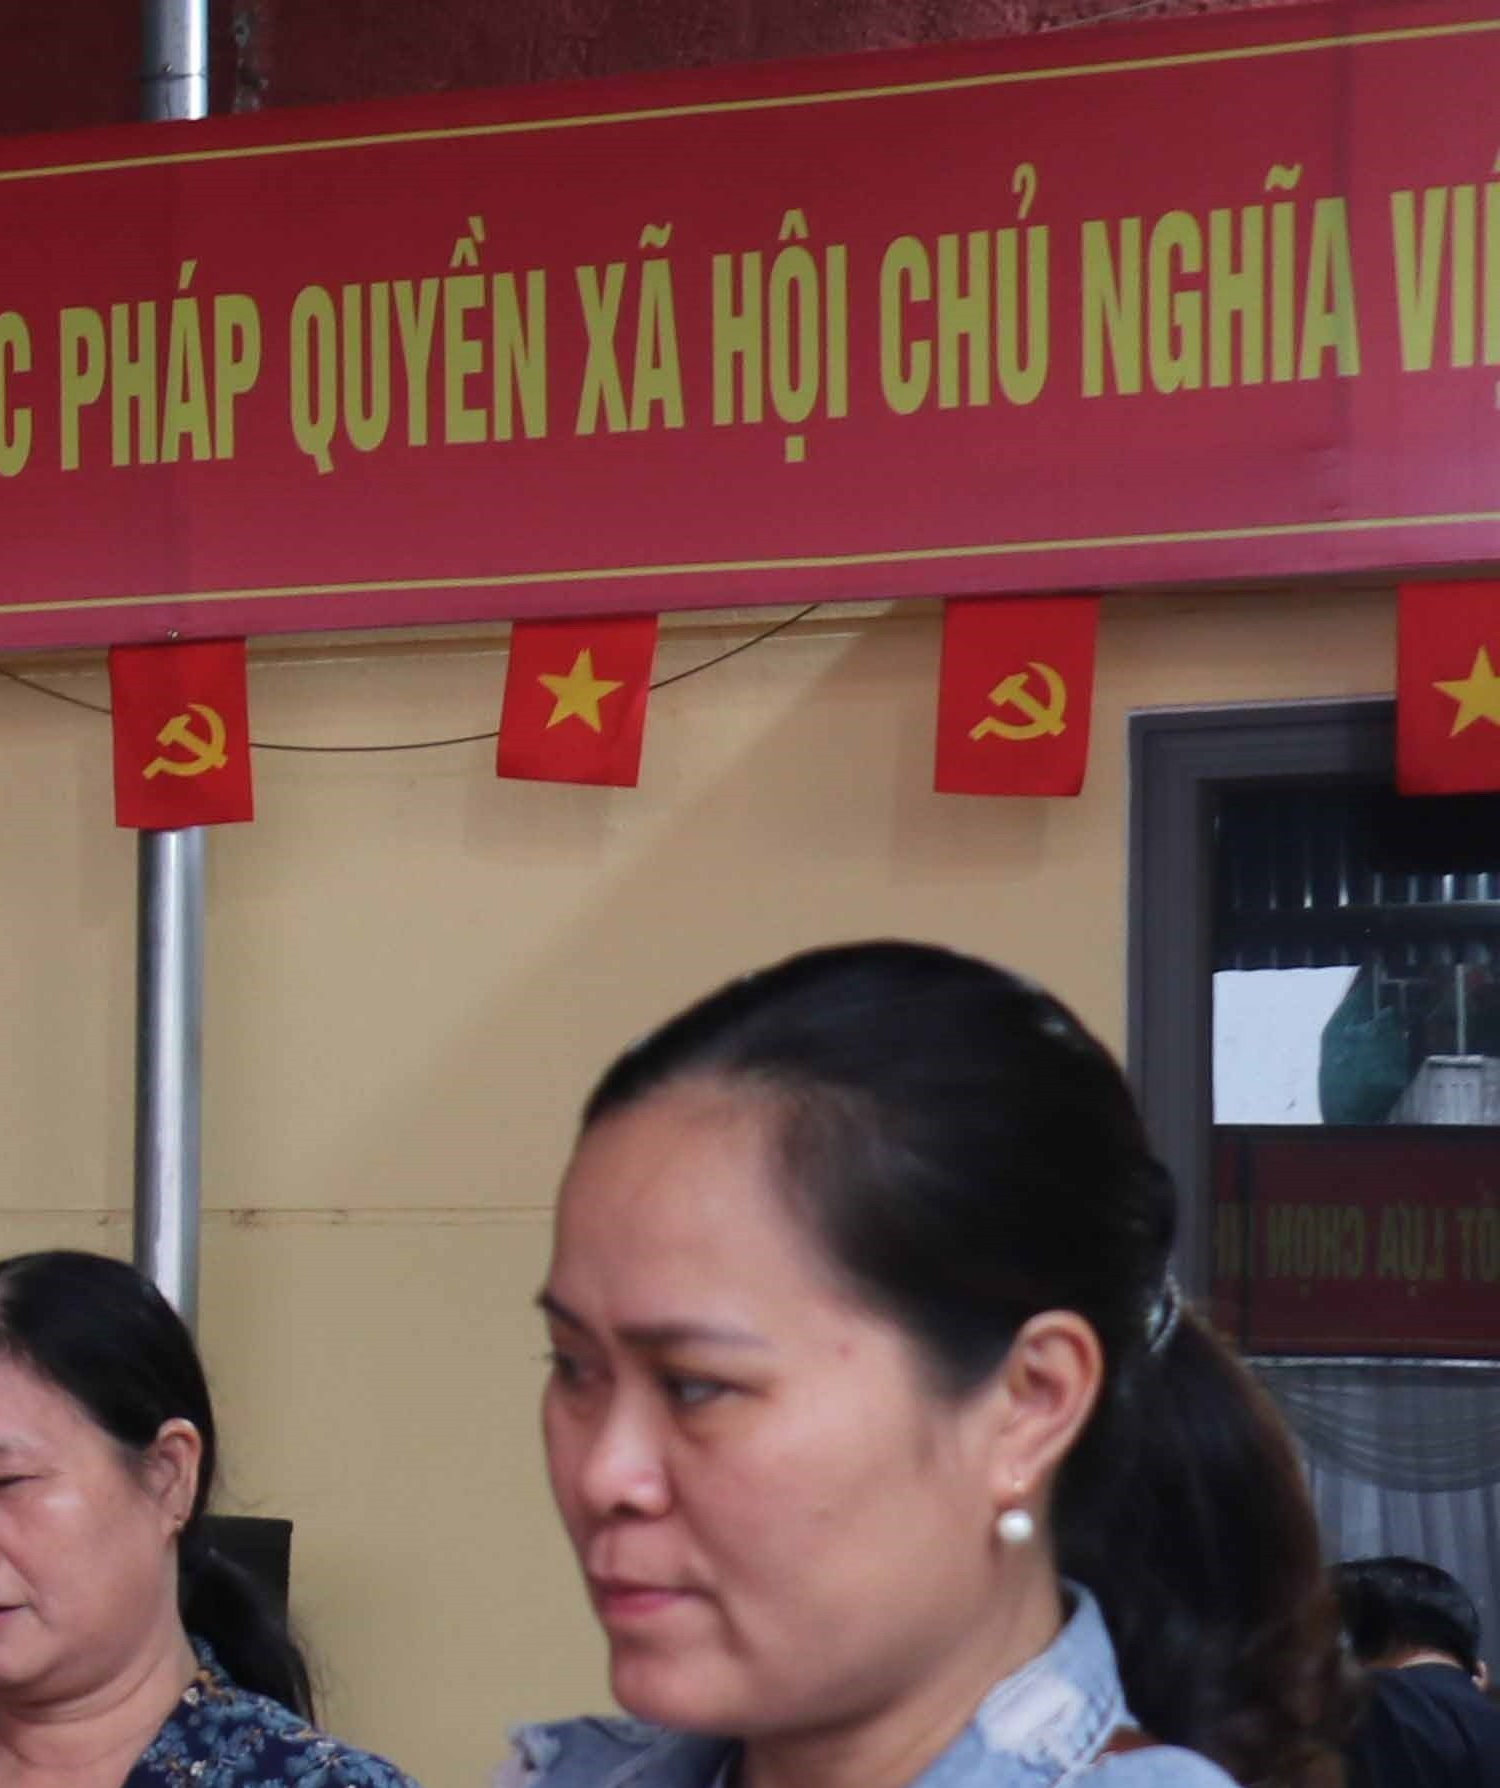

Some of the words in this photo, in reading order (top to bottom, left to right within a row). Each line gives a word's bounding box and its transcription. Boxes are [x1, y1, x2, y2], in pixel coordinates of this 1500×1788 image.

[62, 262, 260, 469] PHÁP
[292, 218, 546, 471] QUYỀN
[578, 226, 684, 434] XÃ
[714, 211, 847, 460] HỘI
[882, 165, 1048, 413] CHỦ
[1084, 166, 1360, 395] NGHĨA
